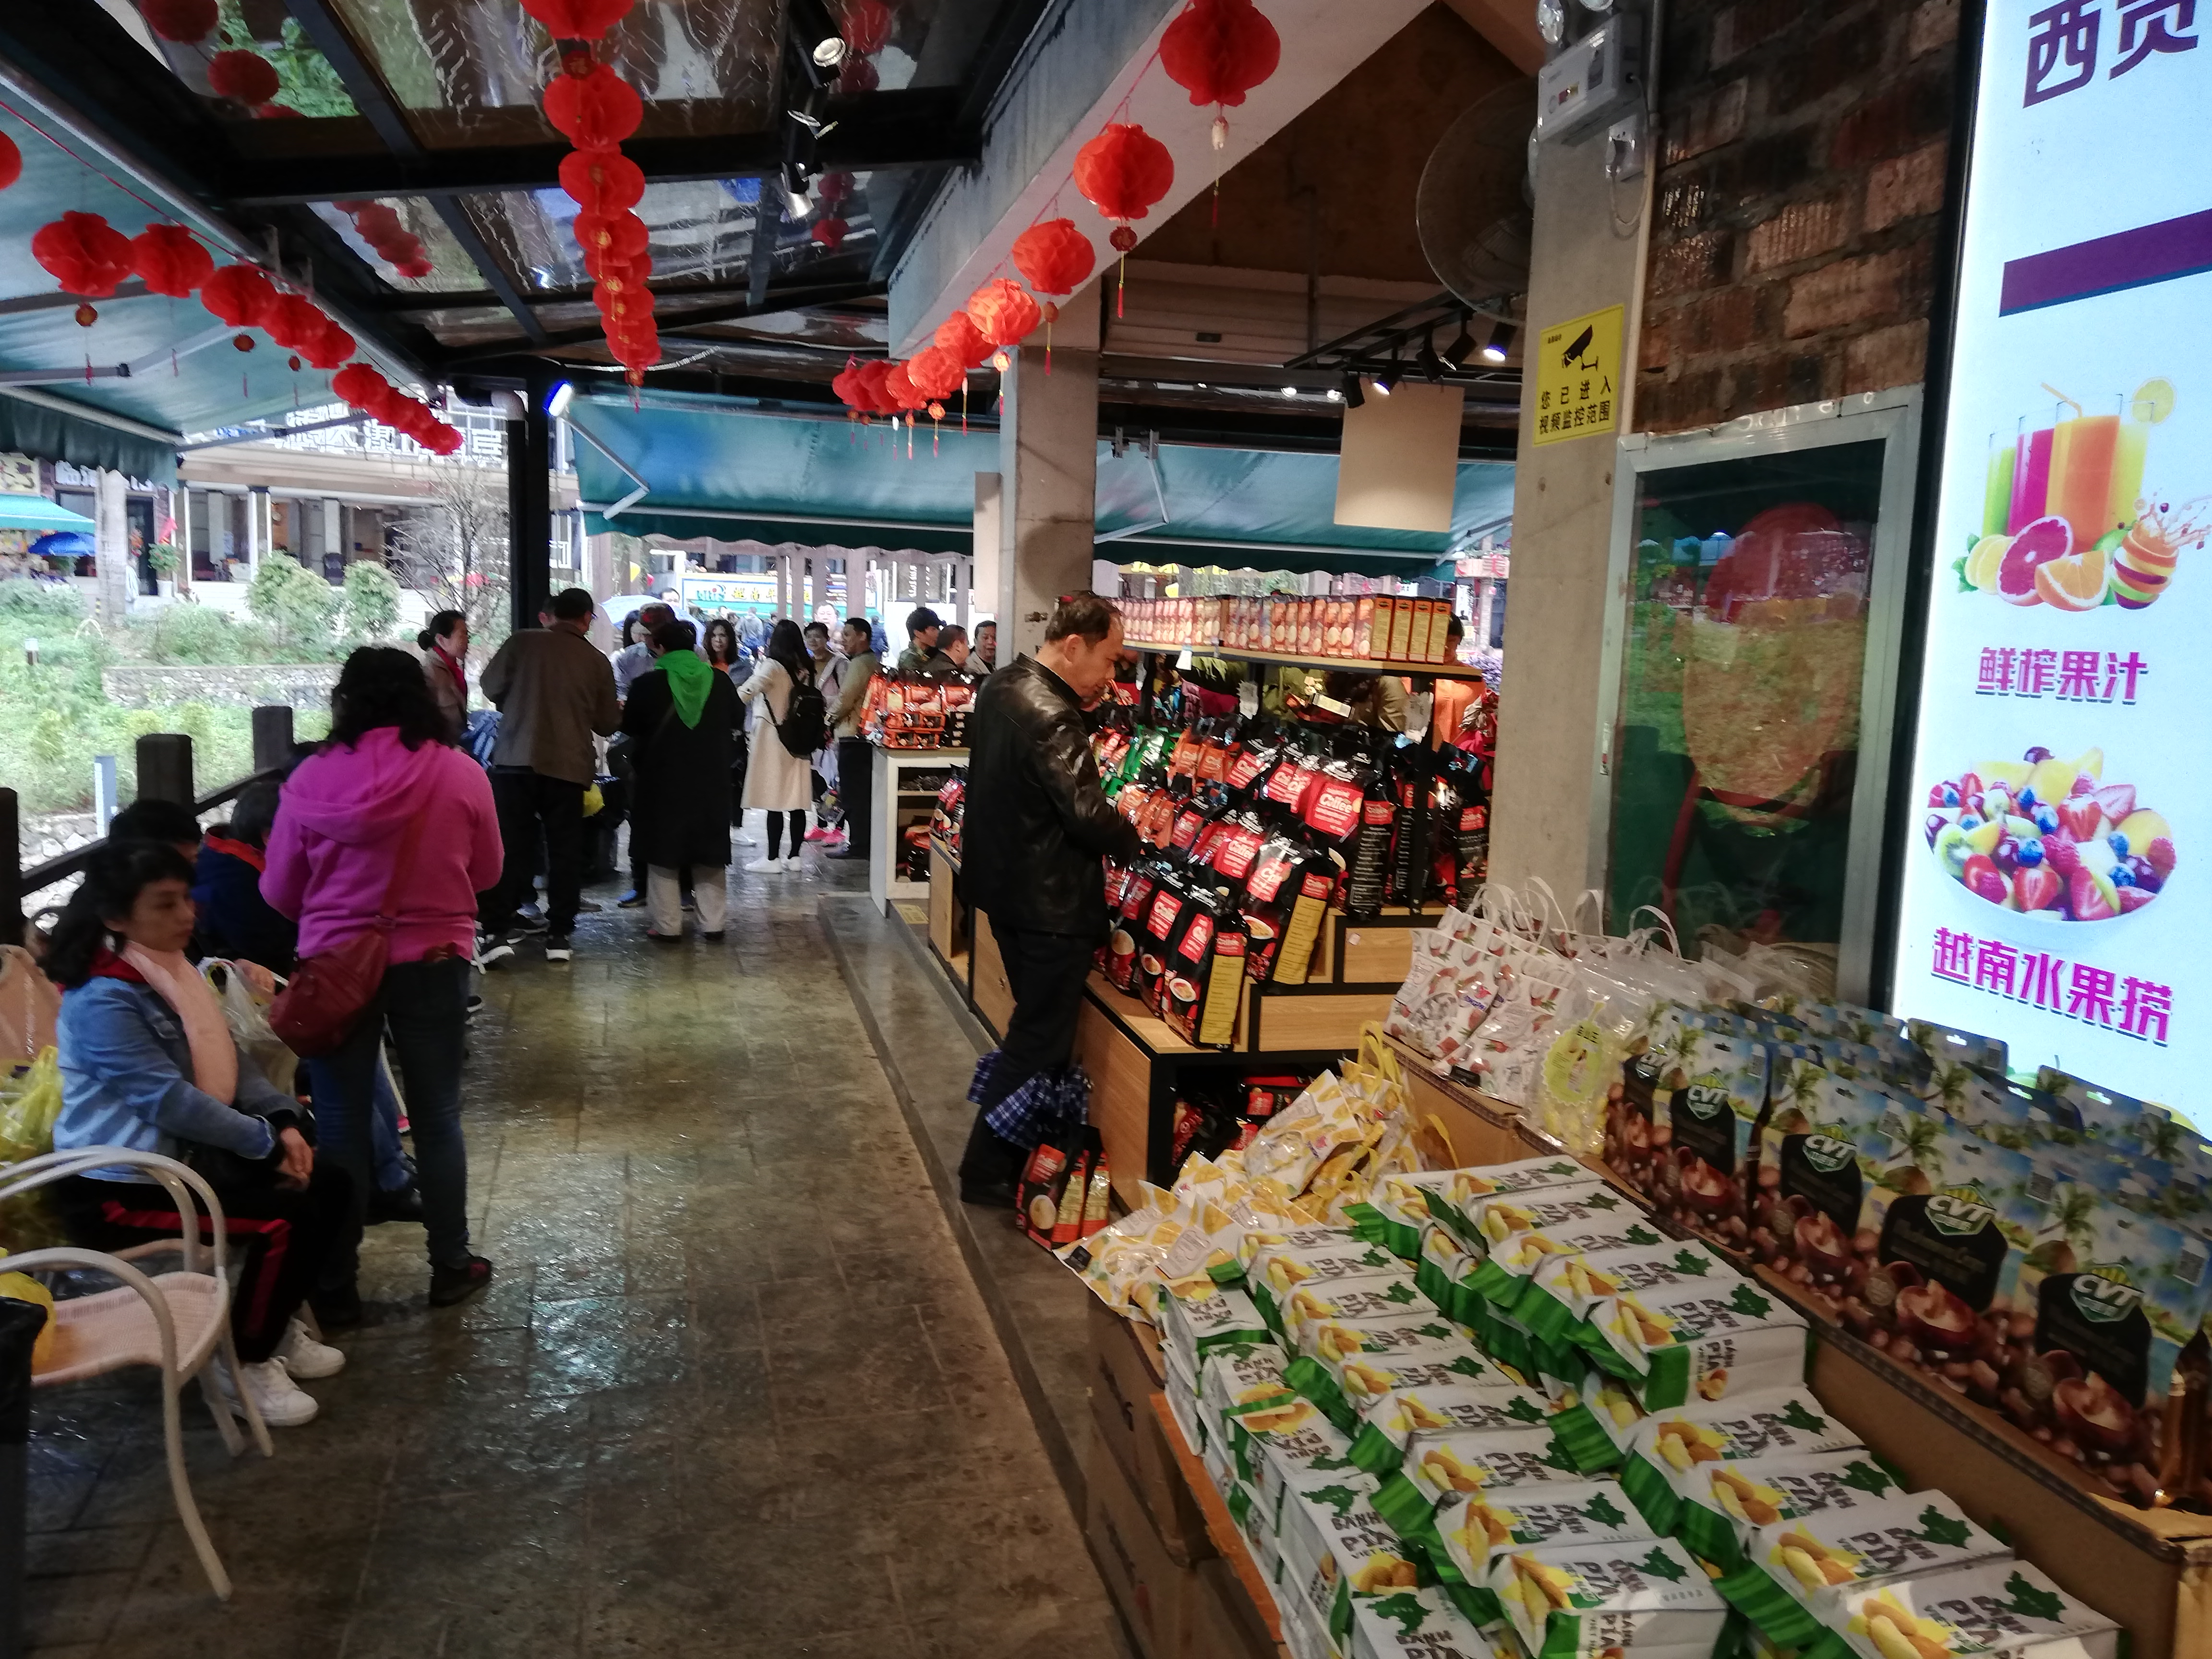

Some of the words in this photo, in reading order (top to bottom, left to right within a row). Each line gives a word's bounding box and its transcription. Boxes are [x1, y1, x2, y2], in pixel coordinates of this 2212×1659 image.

[2022, 0, 2199, 109] 西贡
[1975, 647, 2149, 706] 鲜榨果汁
[1319, 793, 1354, 814] Coffee
[1931, 926, 2175, 1048] 越南水果捞
[1687, 1084, 1731, 1103] CVT
[1804, 1134, 1858, 1158] CVT
[1927, 1195, 1996, 1222] CVT
[2072, 1274, 2145, 1306] CVT
